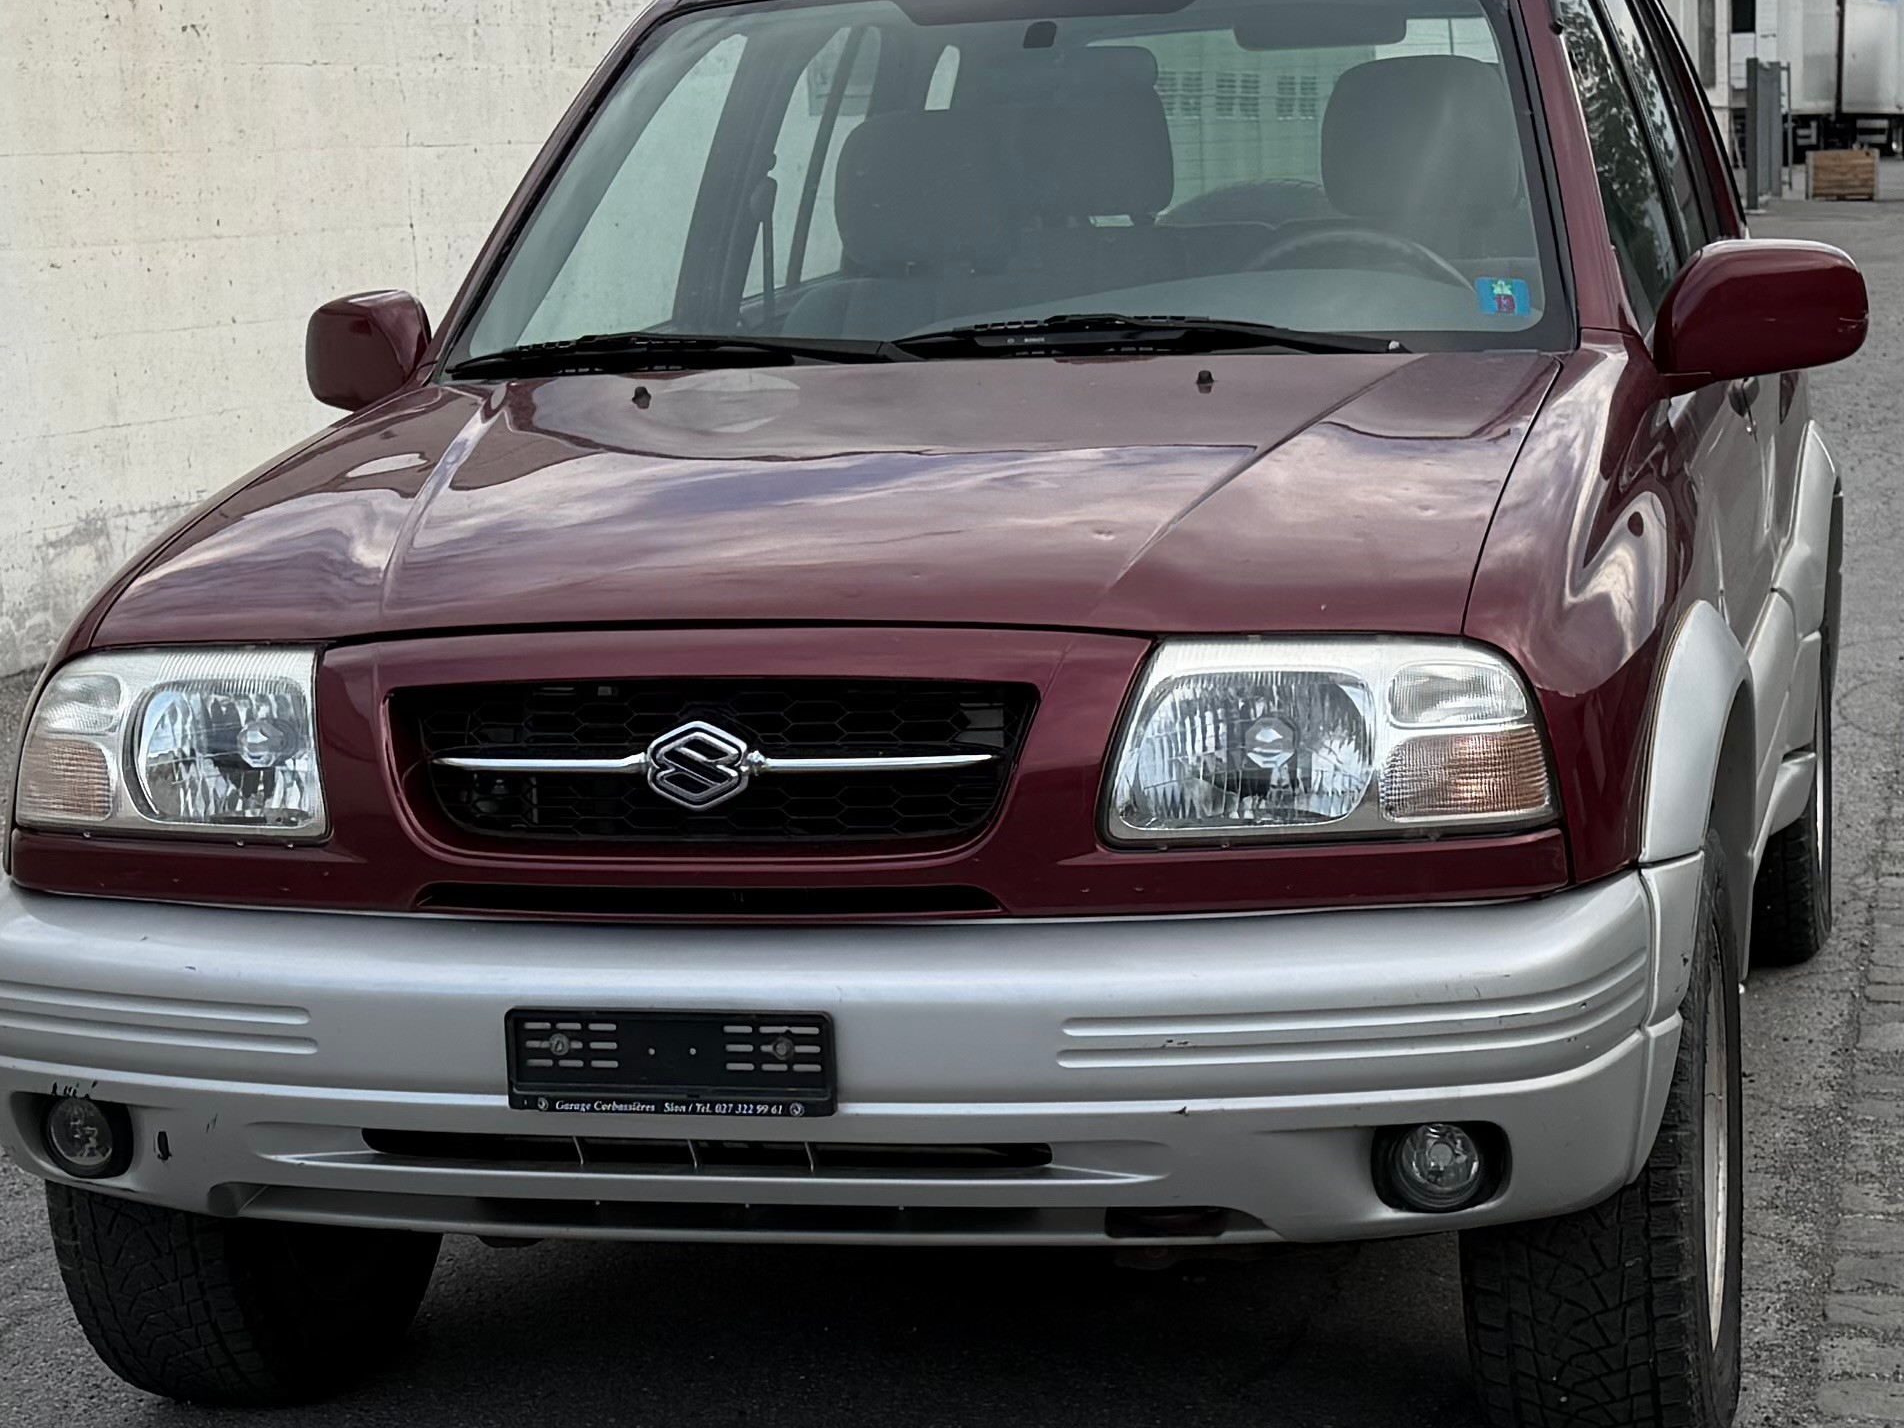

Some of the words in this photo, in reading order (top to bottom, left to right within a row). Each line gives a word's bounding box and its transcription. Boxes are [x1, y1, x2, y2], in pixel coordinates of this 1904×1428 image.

[555, 1100, 591, 1112] Garage
[663, 1102, 686, 1113] Sion
[714, 1103, 734, 1114] 027
[735, 1103, 754, 1115] 322
[756, 1104, 770, 1115] 99
[770, 1104, 783, 1115] 61
